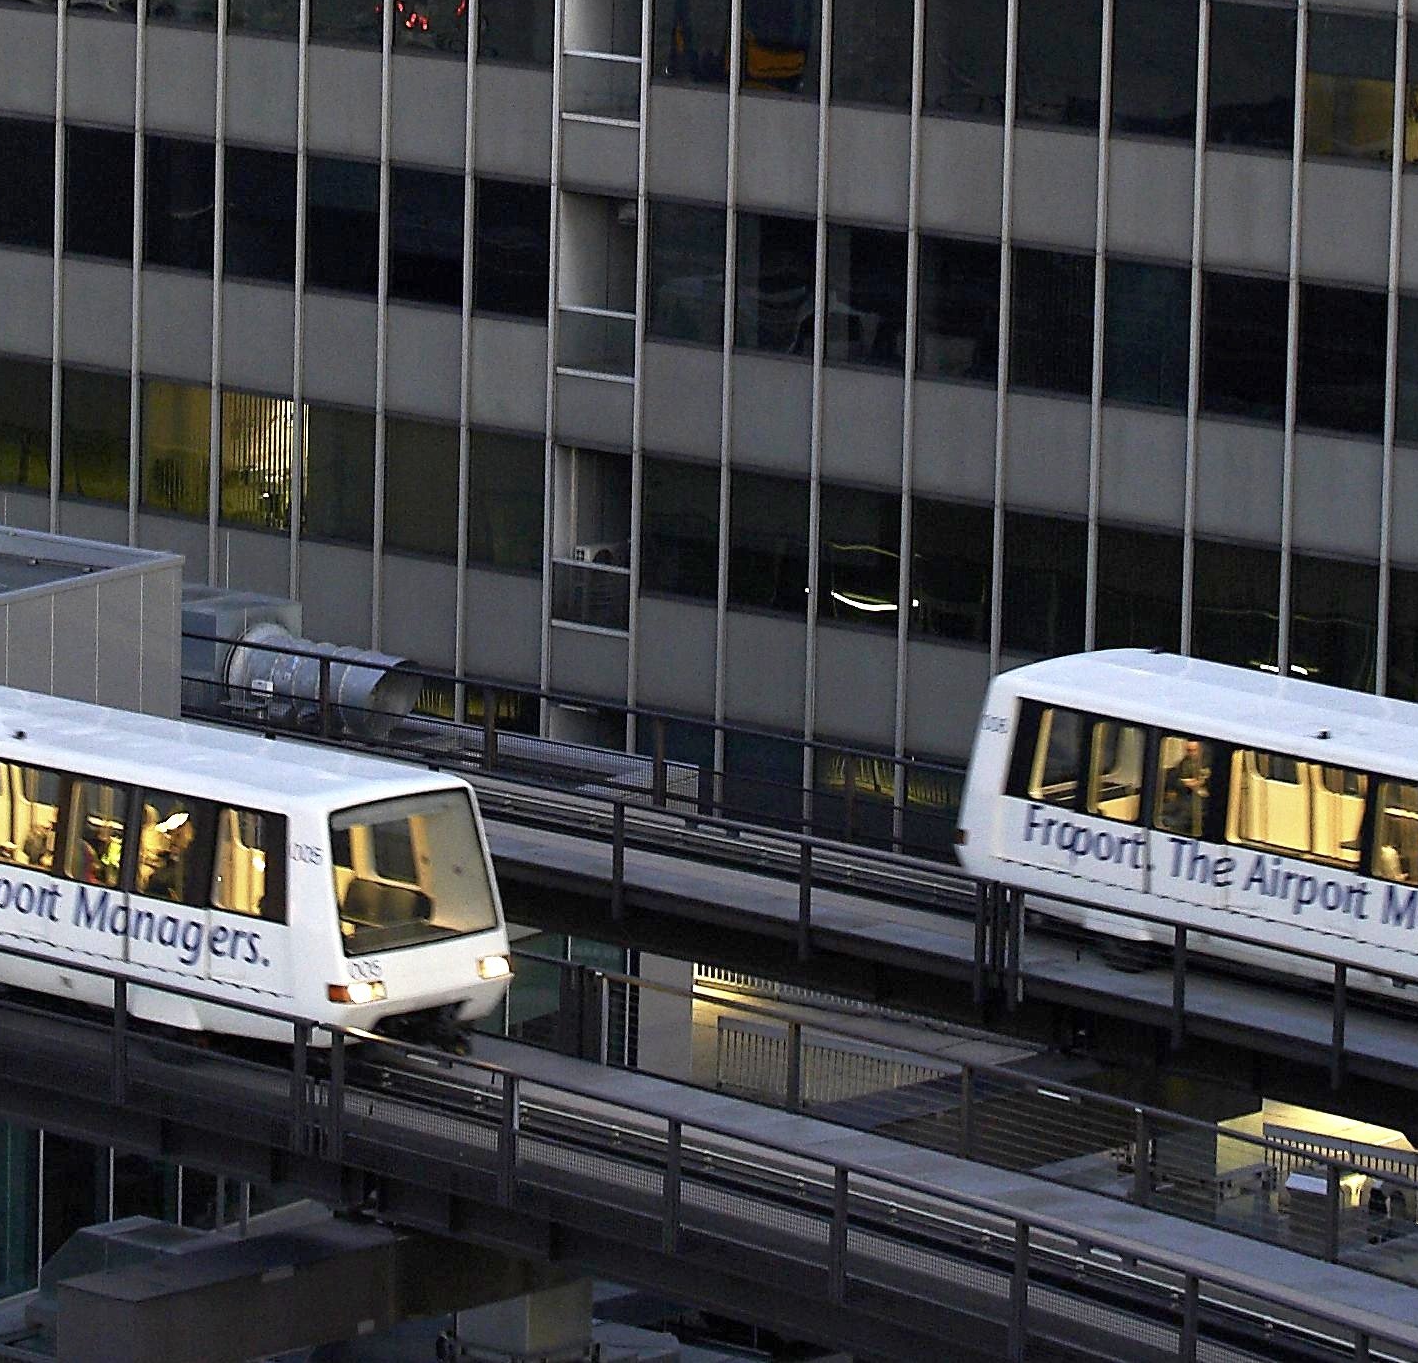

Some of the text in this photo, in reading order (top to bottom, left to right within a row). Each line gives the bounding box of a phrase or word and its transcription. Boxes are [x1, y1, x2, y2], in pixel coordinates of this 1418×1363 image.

[1024, 804, 1154, 872] Fraport.
[1168, 837, 1236, 888] The
[1243, 854, 1371, 919] Airport
[72, 885, 271, 967] Managers.
